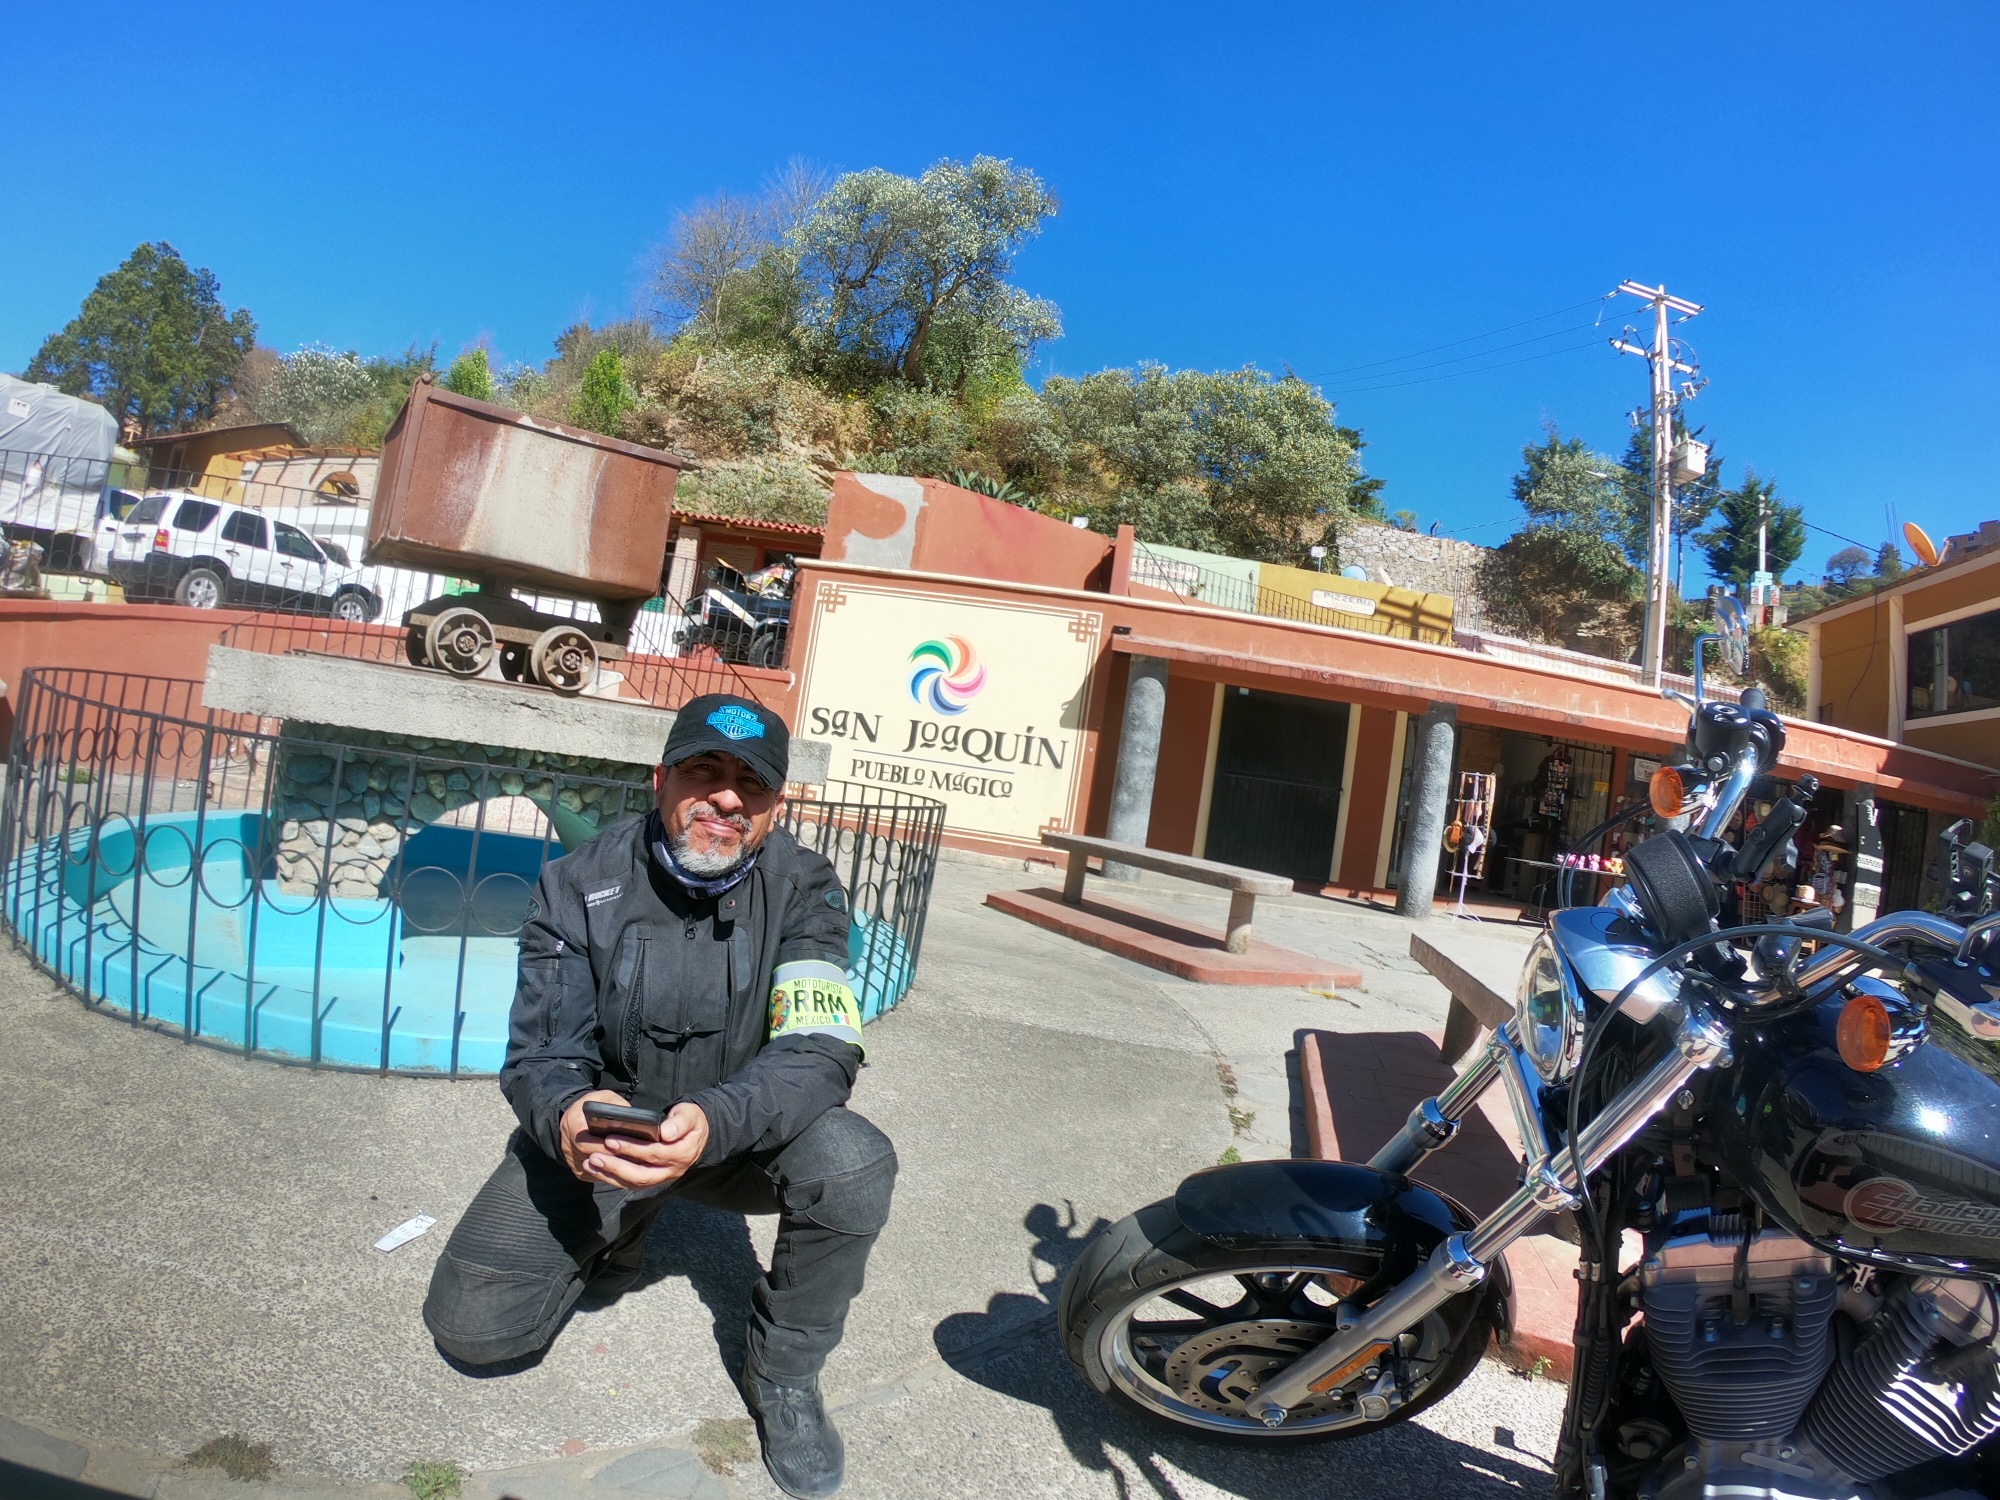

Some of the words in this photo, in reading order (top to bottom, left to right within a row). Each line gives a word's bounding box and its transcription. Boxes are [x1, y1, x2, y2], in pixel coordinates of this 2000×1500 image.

[1323, 591, 1374, 607] PIZZERIA
[725, 708, 753, 721] MOTOR
[793, 979, 843, 995] MOTOTURISTA
[794, 989, 849, 1015] RRM
